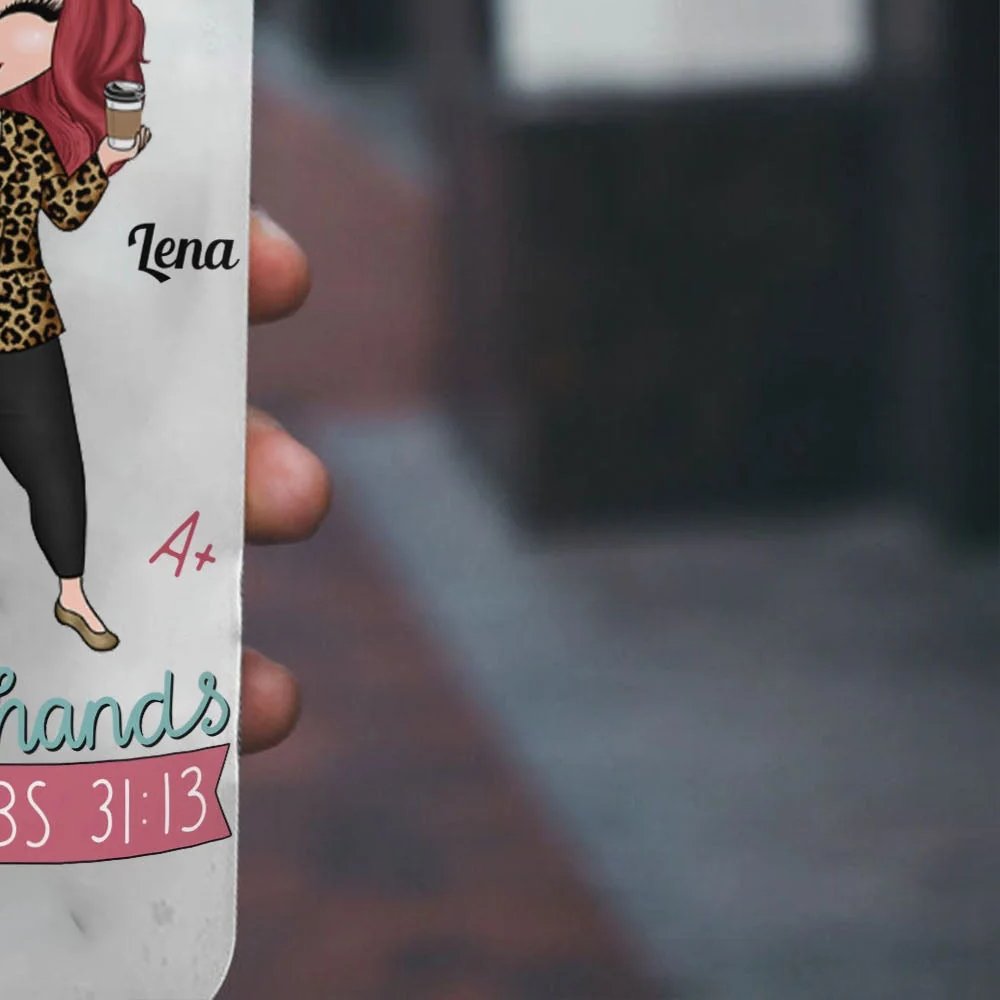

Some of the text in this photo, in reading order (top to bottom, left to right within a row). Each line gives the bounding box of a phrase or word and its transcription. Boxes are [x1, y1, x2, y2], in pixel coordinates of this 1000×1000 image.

[128, 223, 240, 283] Lena
[149, 511, 216, 577] A+
[91, 766, 207, 843] 31:13
